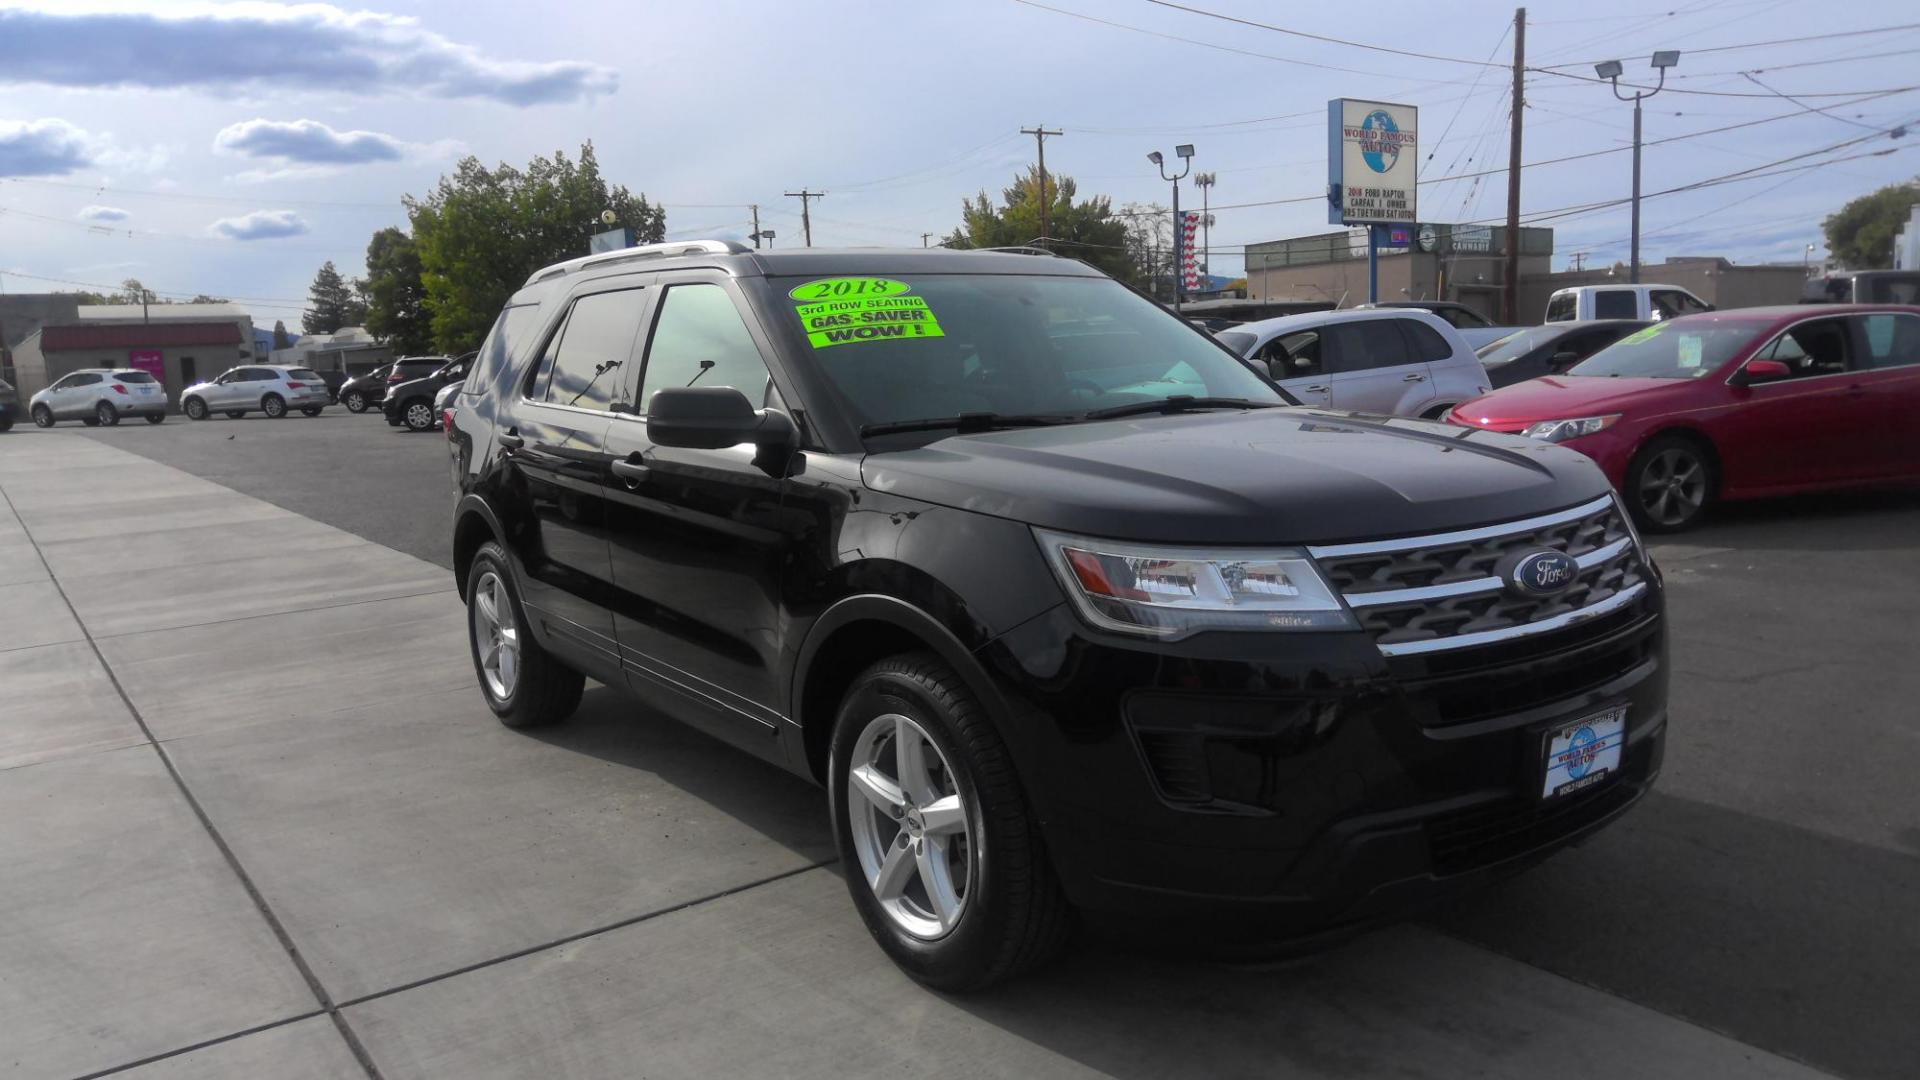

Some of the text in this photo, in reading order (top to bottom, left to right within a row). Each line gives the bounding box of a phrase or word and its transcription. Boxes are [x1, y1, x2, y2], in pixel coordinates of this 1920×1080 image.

[1344, 128, 1415, 143] WORLD FAMOUS
[1361, 141, 1399, 154] AUTOS
[1365, 188, 1380, 198] FORD
[1382, 189, 1405, 199] RAPTOR
[1351, 198, 1374, 208] CARFAX
[1387, 200, 1406, 209] OWNER
[815, 279, 889, 298] 2018
[801, 298, 924, 316] 3rd ROW SEATING
[810, 309, 925, 329] GAS-SAVER
[825, 325, 905, 342] WOW
[1536, 558, 1570, 586] Ford
